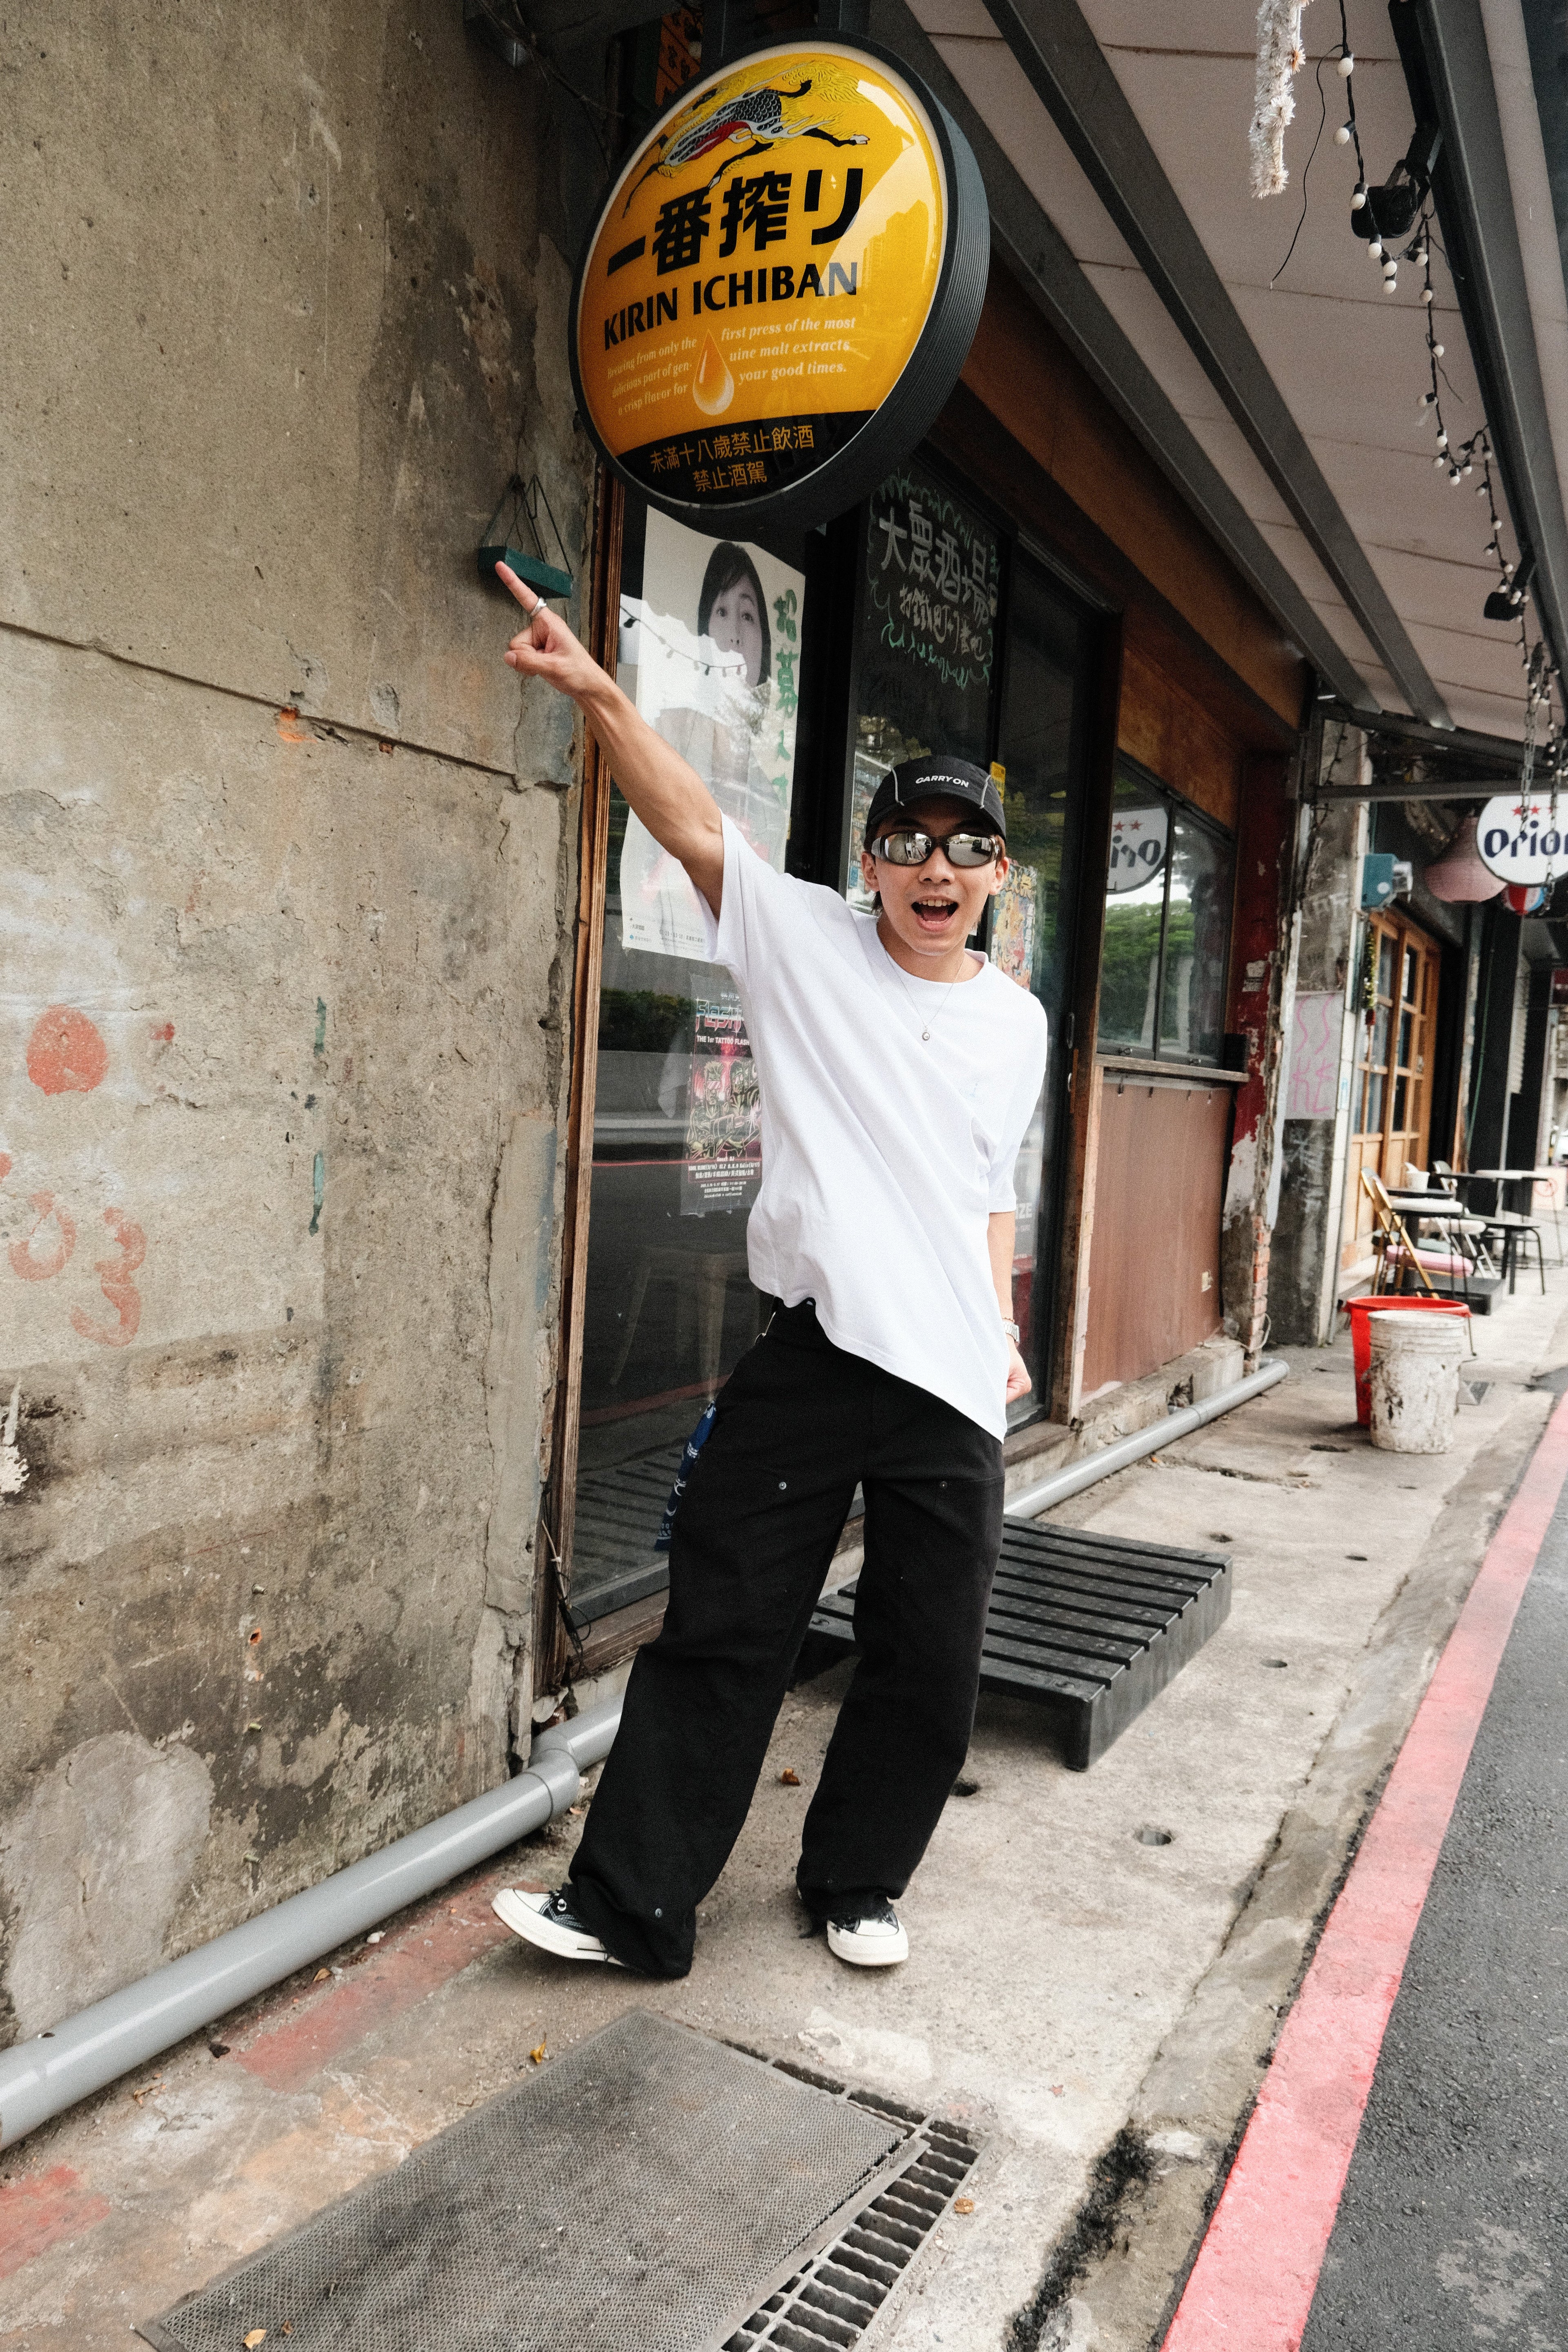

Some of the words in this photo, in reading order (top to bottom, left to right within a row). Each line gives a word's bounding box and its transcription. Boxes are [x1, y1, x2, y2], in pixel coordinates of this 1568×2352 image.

[606, 168, 863, 277] 一番搾り
[604, 287, 678, 351] KIRIN
[693, 261, 858, 315] ICHIBAN
[722, 326, 746, 341] first
[749, 323, 781, 340] press
[785, 318, 799, 332] of
[800, 317, 820, 331] the
[824, 317, 856, 329] most
[608, 358, 635, 379] Brewing
[637, 350, 656, 365] from
[659, 341, 679, 356] only
[682, 337, 697, 350] the
[729, 348, 756, 361] uine
[760, 342, 789, 357] malt
[793, 339, 850, 354] extracts
[612, 378, 641, 399] delicious
[643, 368, 660, 387] part
[662, 363, 672, 376] of
[738, 369, 768, 385] your
[771, 362, 804, 381] good
[807, 361, 847, 374] times.
[618, 408, 623, 416] a
[625, 398, 643, 413] crisp
[644, 389, 671, 405] flavor
[674, 383, 688, 396] for
[650, 425, 815, 473] 未滿十八歲禁止飲酒
[692, 461, 768, 492] 禁止酒駕
[915, 775, 953, 784] CARRY
[953, 778, 969, 788] ON
[1484, 820, 1568, 858] Orio
